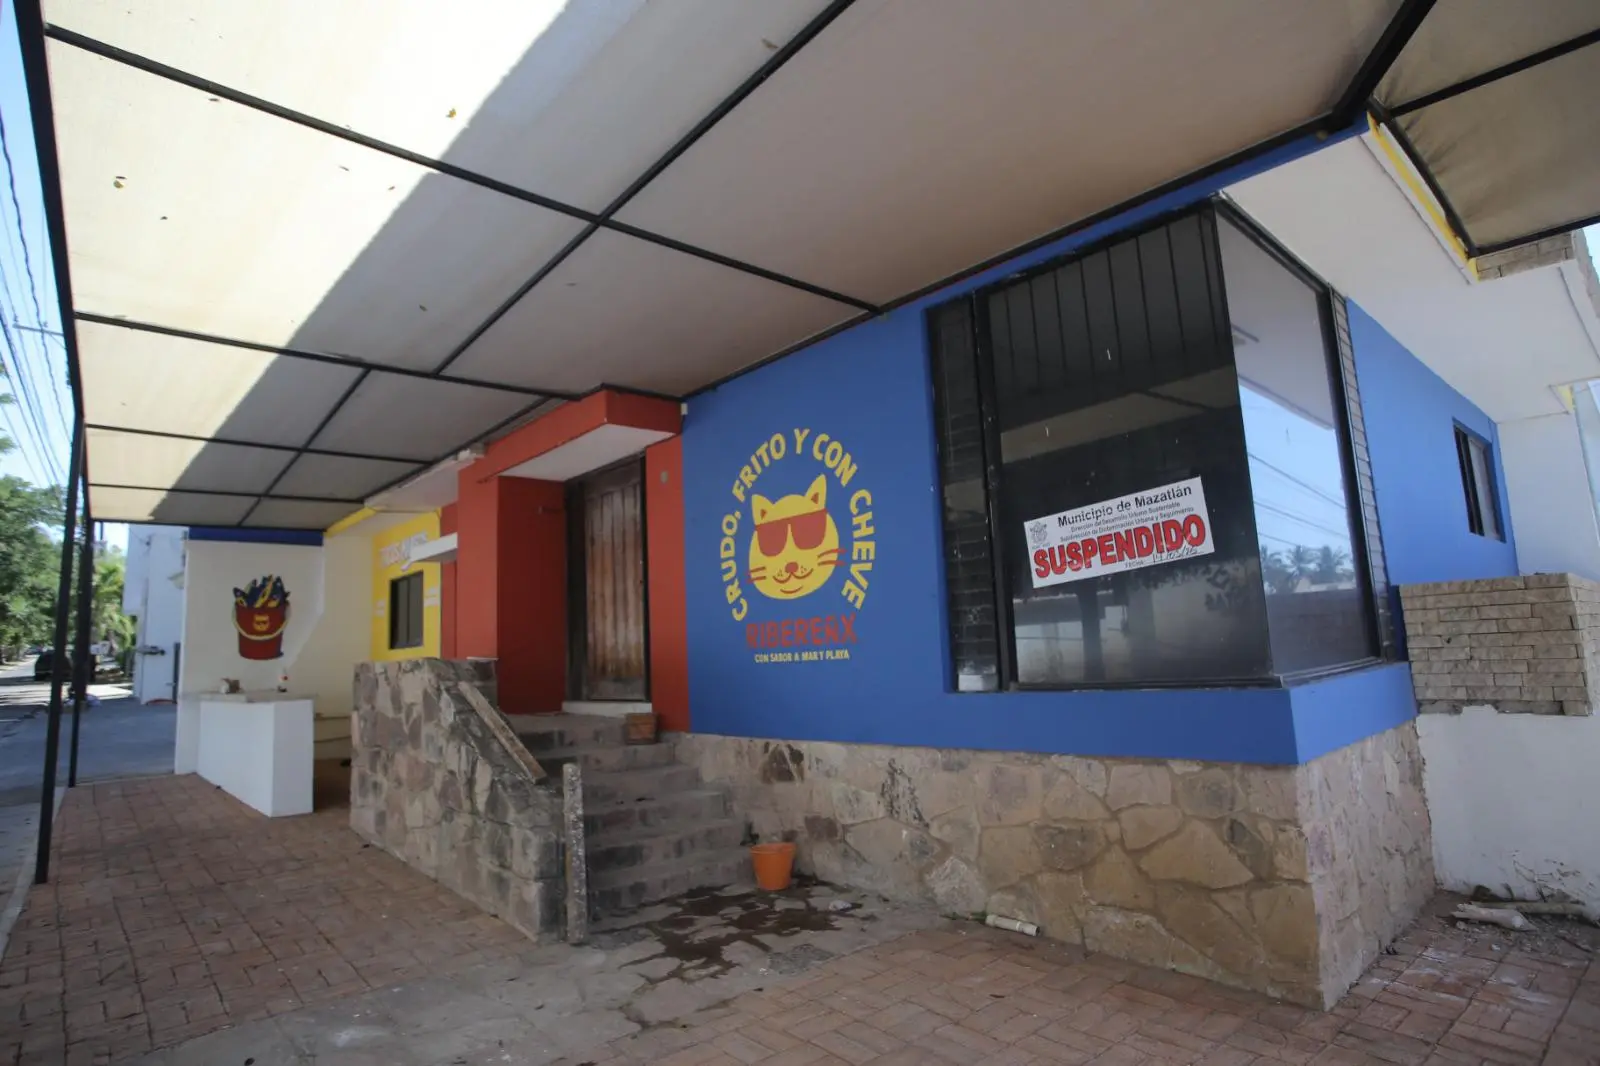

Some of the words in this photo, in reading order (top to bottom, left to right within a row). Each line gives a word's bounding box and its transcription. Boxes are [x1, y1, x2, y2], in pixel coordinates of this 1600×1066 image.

[732, 433, 786, 503] FRITO
[794, 428, 810, 454] Y
[813, 433, 858, 487] CON
[1058, 505, 1113, 528] Municipio
[1117, 500, 1131, 512] de
[1134, 485, 1192, 509] Mazatlán
[719, 510, 748, 621] CRUDO,
[841, 488, 876, 610] CHEVE
[1033, 513, 1206, 578] SUSPENDIDO
[754, 653, 769, 663] CON
[770, 651, 793, 662] SABOR
[794, 651, 801, 661] A
[825, 647, 850, 660] PLAYA
